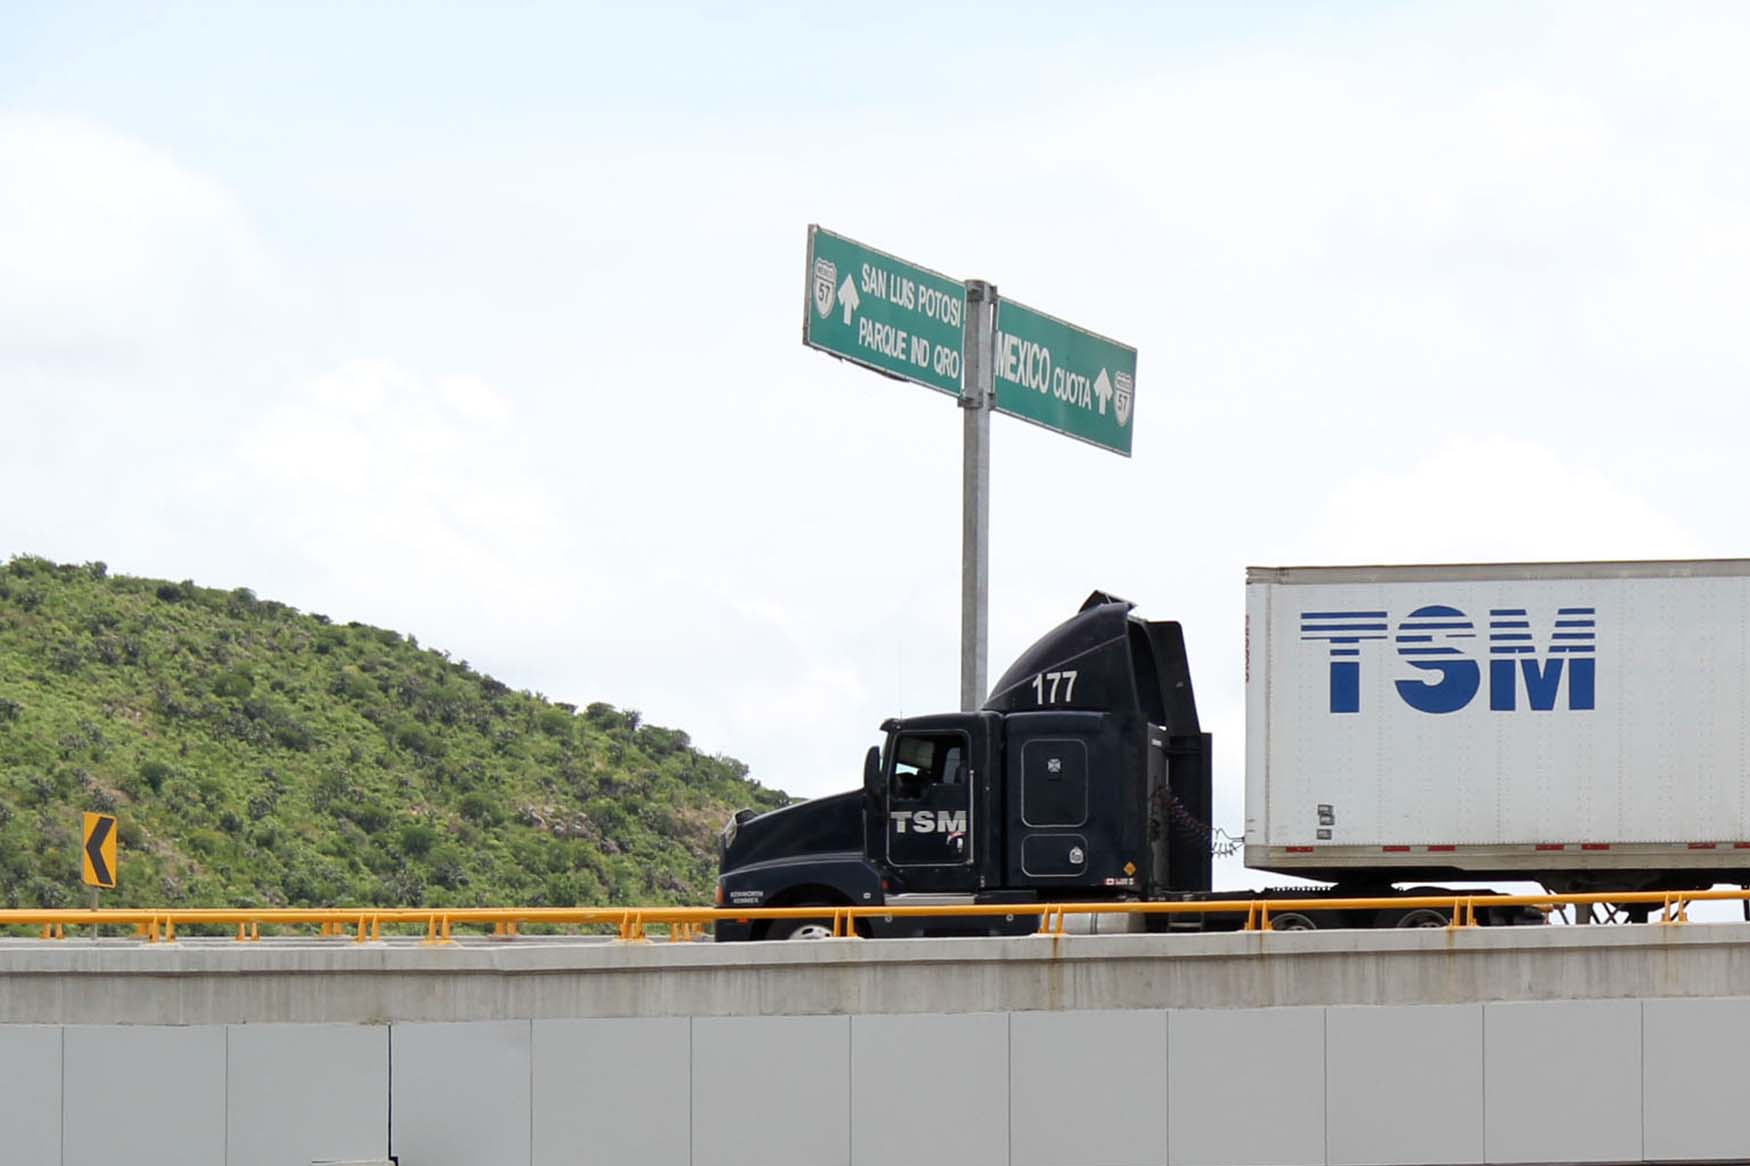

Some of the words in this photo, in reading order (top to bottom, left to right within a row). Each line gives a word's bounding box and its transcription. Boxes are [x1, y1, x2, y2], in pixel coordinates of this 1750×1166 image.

[818, 282, 831, 302] 57
[861, 263, 887, 299] SAN
[889, 274, 915, 310] LUIS
[918, 285, 961, 328] POTOSI
[858, 317, 907, 361] PARQUE
[910, 336, 930, 368] IND
[933, 345, 960, 378] QRO
[995, 331, 1050, 394] MEXICO
[1053, 366, 1092, 411] CUOTA
[1032, 670, 1078, 705] 177
[1301, 605, 1596, 714] TSM
[890, 810, 967, 833] TSM
